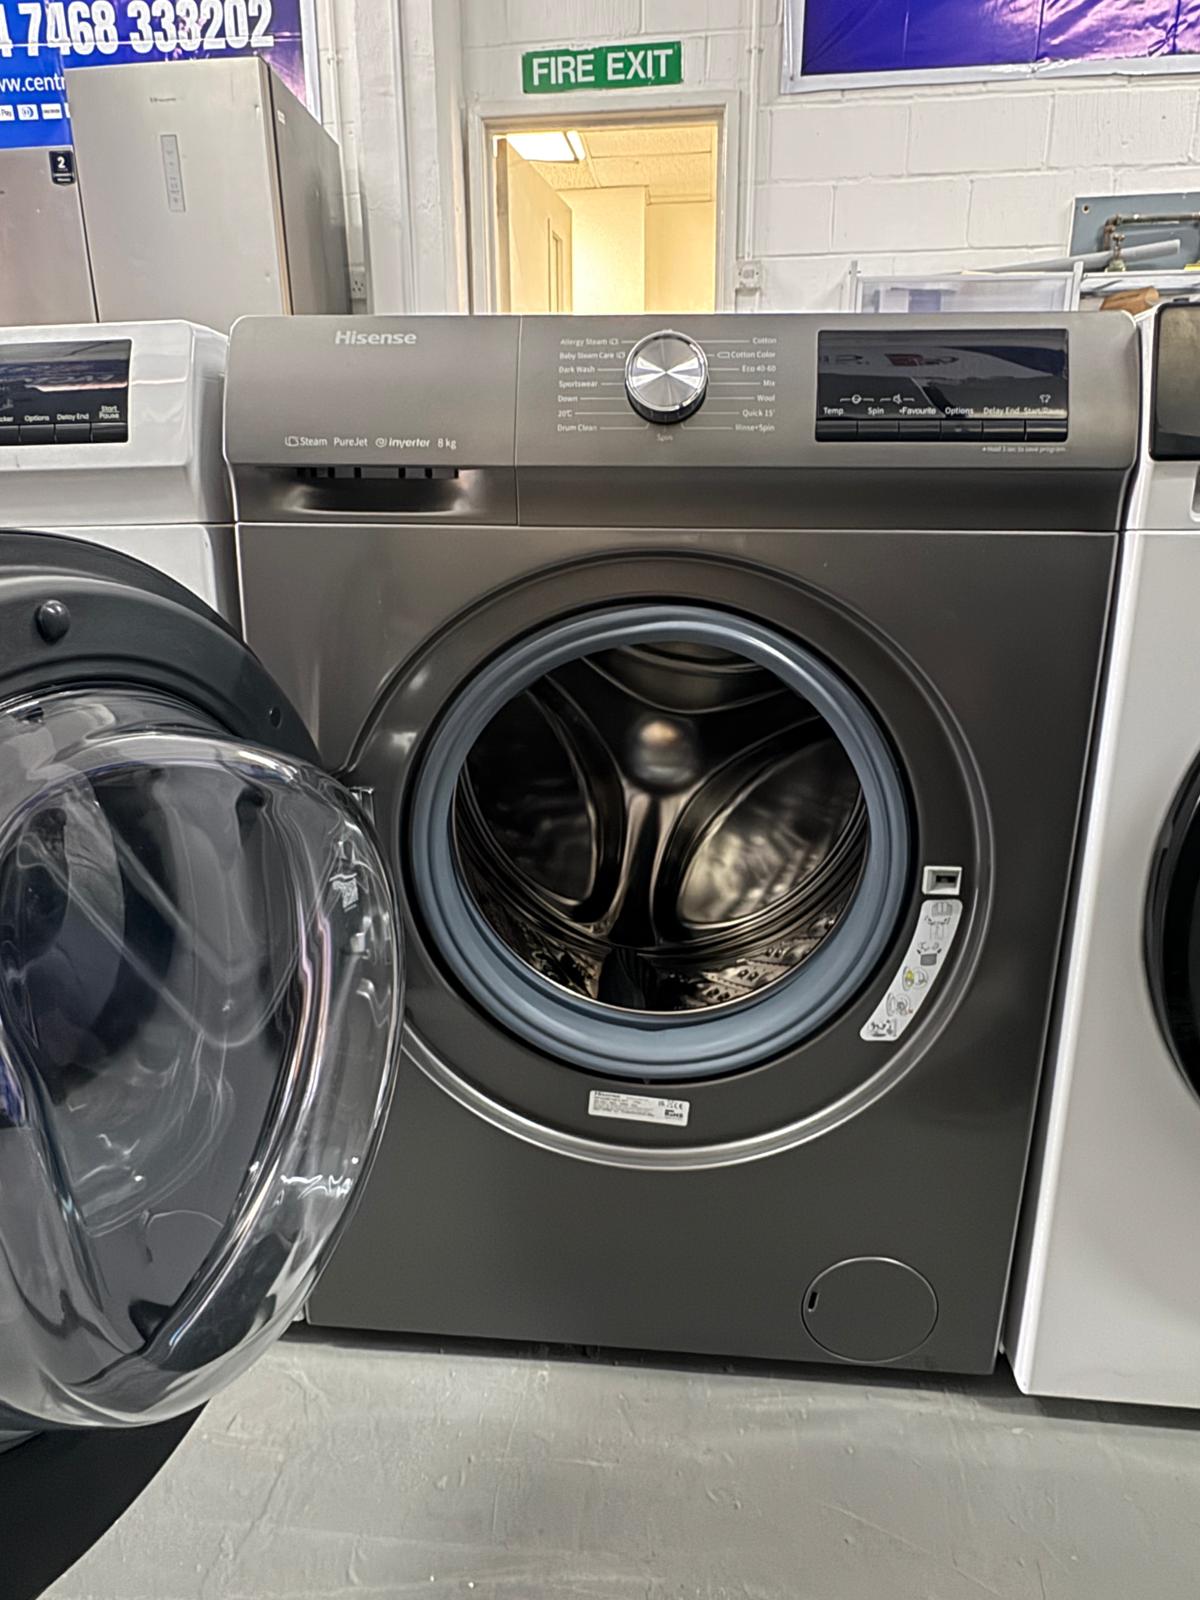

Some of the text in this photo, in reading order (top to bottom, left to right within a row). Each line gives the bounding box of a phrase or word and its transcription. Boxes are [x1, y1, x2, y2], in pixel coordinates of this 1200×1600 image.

[18, 0, 119, 56] 7468
[127, 0, 274, 53] 333202
[532, 49, 673, 86] FIRE EXIT
[57, 156, 66, 169] 2
[335, 330, 417, 345] Hisense
[560, 338, 584, 347] Allergy
[559, 351, 614, 360] Baby Steam Care
[756, 350, 776, 358] Color
[559, 380, 598, 388] Sportswear
[99, 411, 120, 419] Pause
[742, 409, 763, 417] Quick
[823, 407, 844, 415] Temp
[867, 407, 885, 415] Spin
[945, 407, 974, 415] Options
[984, 407, 1004, 416] Delay
[1006, 407, 1020, 415] End
[24, 415, 50, 423] Options
[557, 424, 598, 432] Drum Clean
[300, 436, 328, 446] Steam
[334, 436, 368, 446] PureJet
[437, 438, 444, 447] 8
[445, 438, 457, 450] kg
